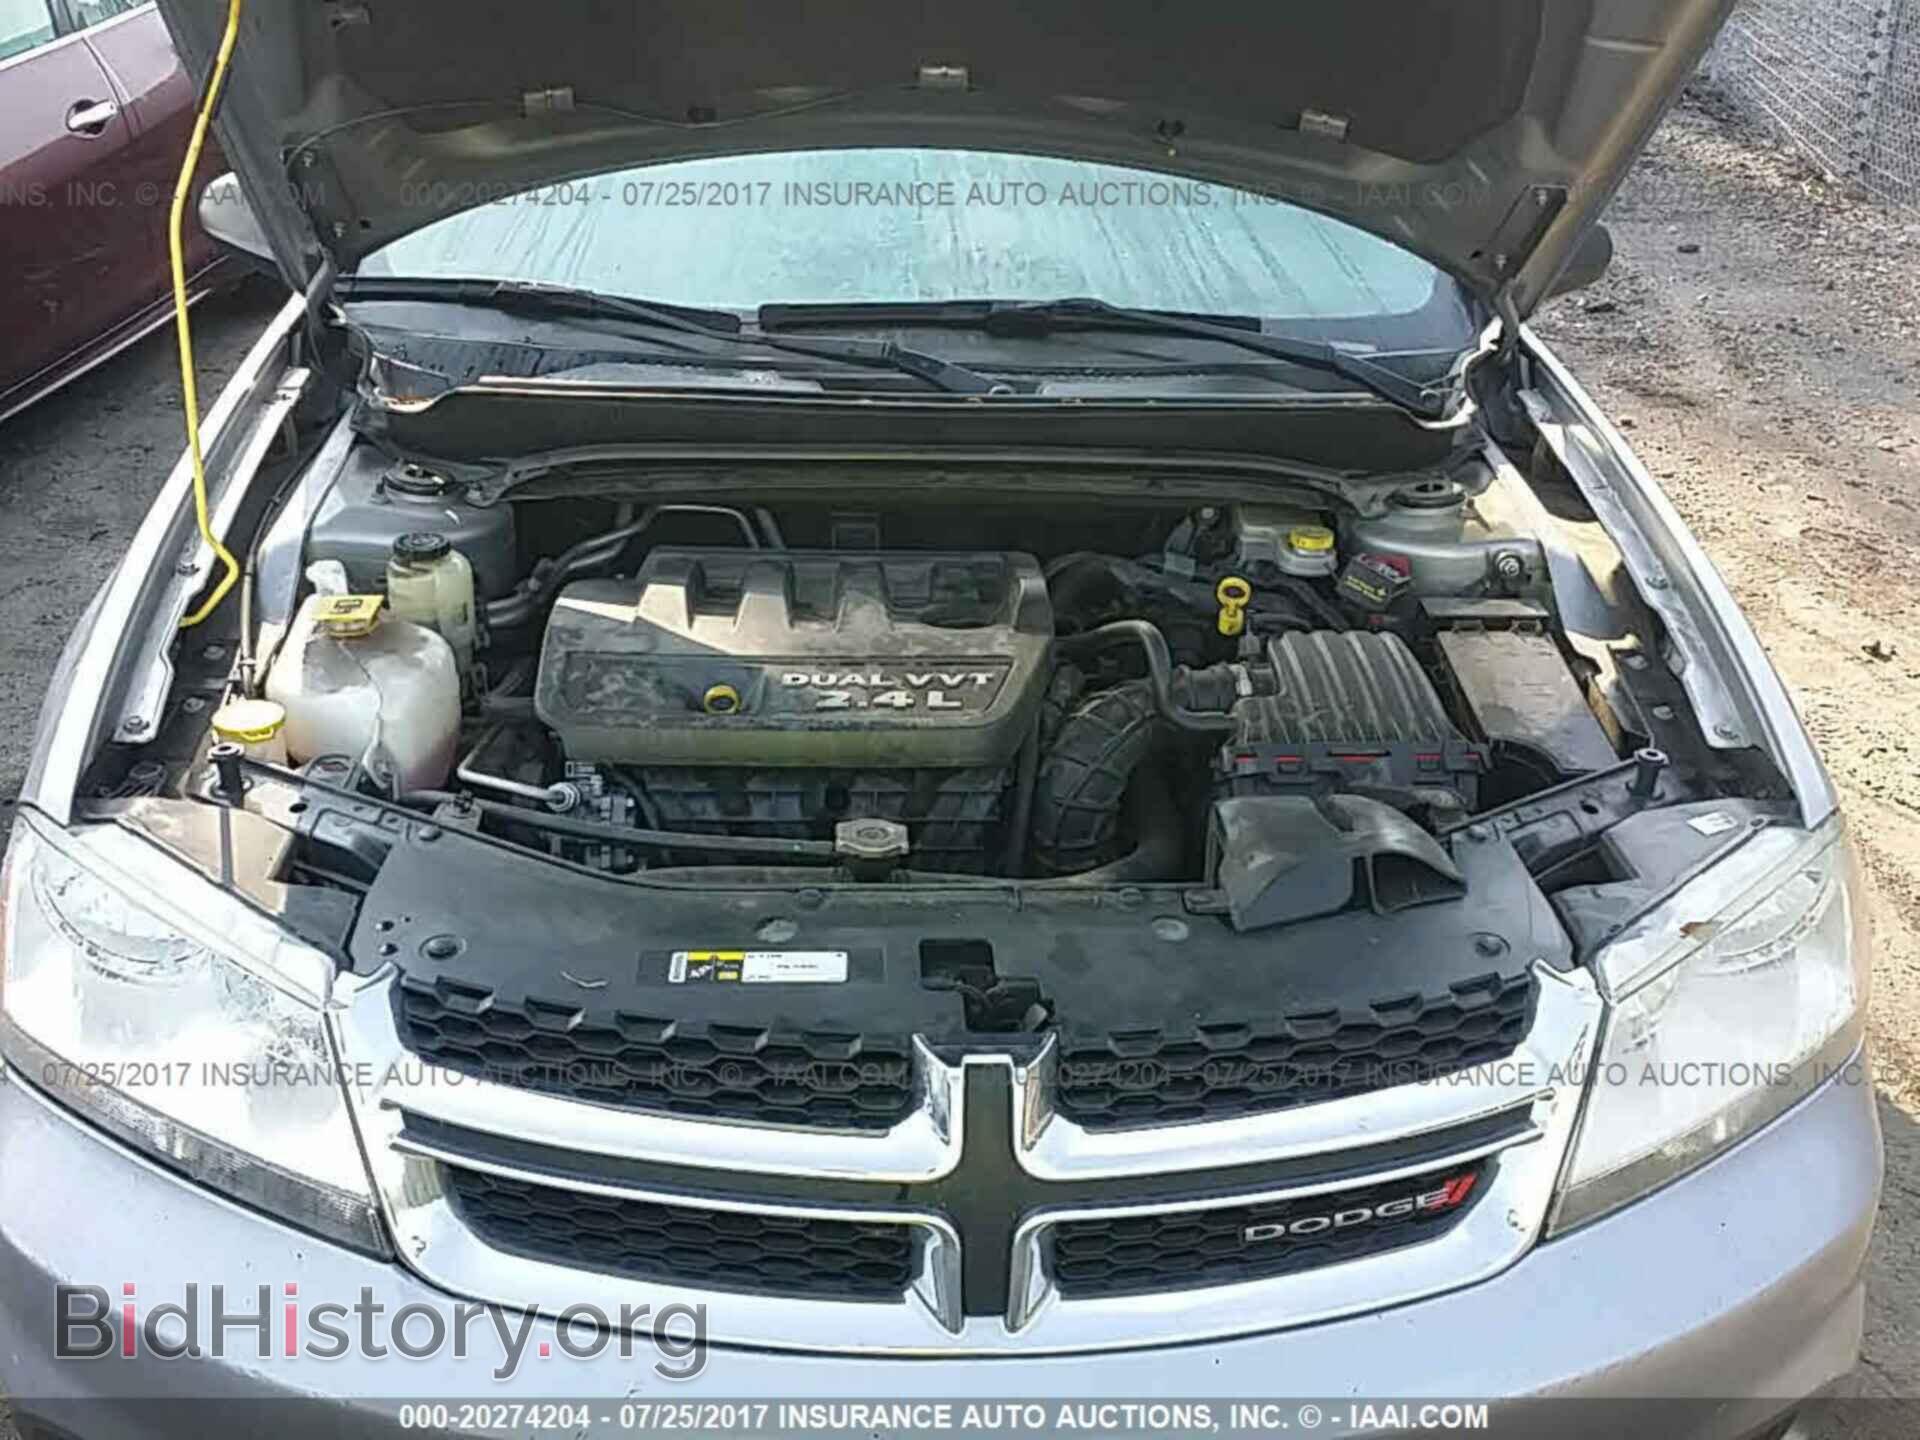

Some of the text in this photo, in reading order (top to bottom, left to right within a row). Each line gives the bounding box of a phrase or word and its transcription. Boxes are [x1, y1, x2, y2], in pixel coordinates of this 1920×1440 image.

[781, 672, 994, 687] DUAL VVT
[1245, 1186, 1450, 1242] DODGE
